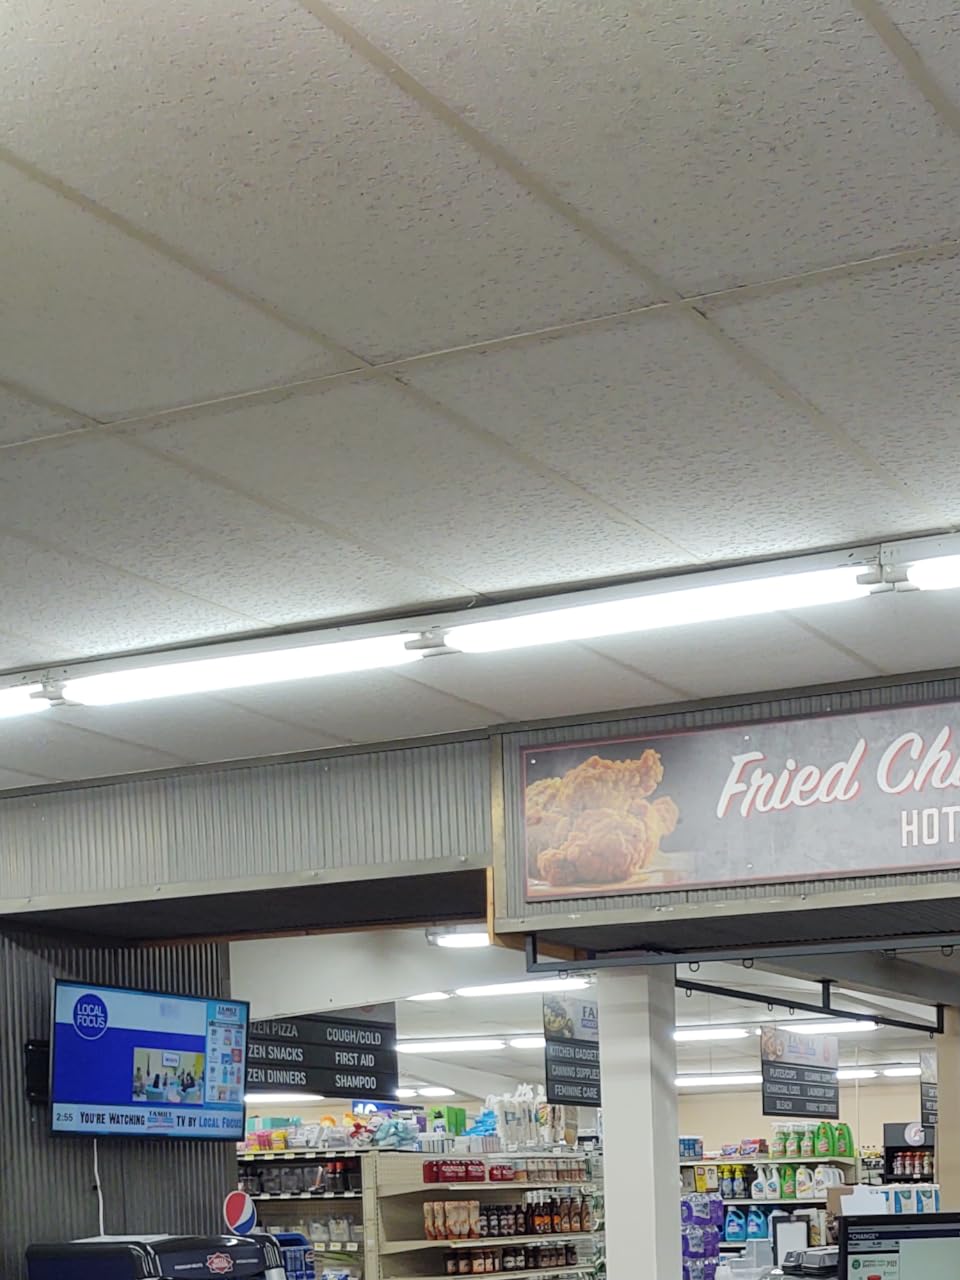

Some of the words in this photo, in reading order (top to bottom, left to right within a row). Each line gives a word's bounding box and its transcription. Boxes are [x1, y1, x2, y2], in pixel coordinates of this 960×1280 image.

[716, 739, 867, 818] Fried
[901, 805, 960, 848] HOT
[77, 1003, 105, 1017] LOCAL
[77, 1015, 106, 1029] FOCUS
[272, 1023, 299, 1038] PIZZA
[326, 1028, 382, 1045] COUGH/COLD
[268, 1046, 304, 1062] SNACKS
[335, 1051, 358, 1066] FIRST
[360, 1053, 375, 1067] AID
[267, 1069, 307, 1085] DINNERS
[335, 1074, 377, 1090] SHAMPOO
[554, 1084, 582, 1097] FEMININE
[582, 1086, 598, 1099] CARE
[56, 1112, 74, 1122] 2:55
[80, 1111, 106, 1126] YOU'RE
[109, 1112, 145, 1126] WATCHING
[176, 1115, 187, 1128] TV
[188, 1117, 198, 1128] BY
[199, 1116, 220, 1129] LOCAL
